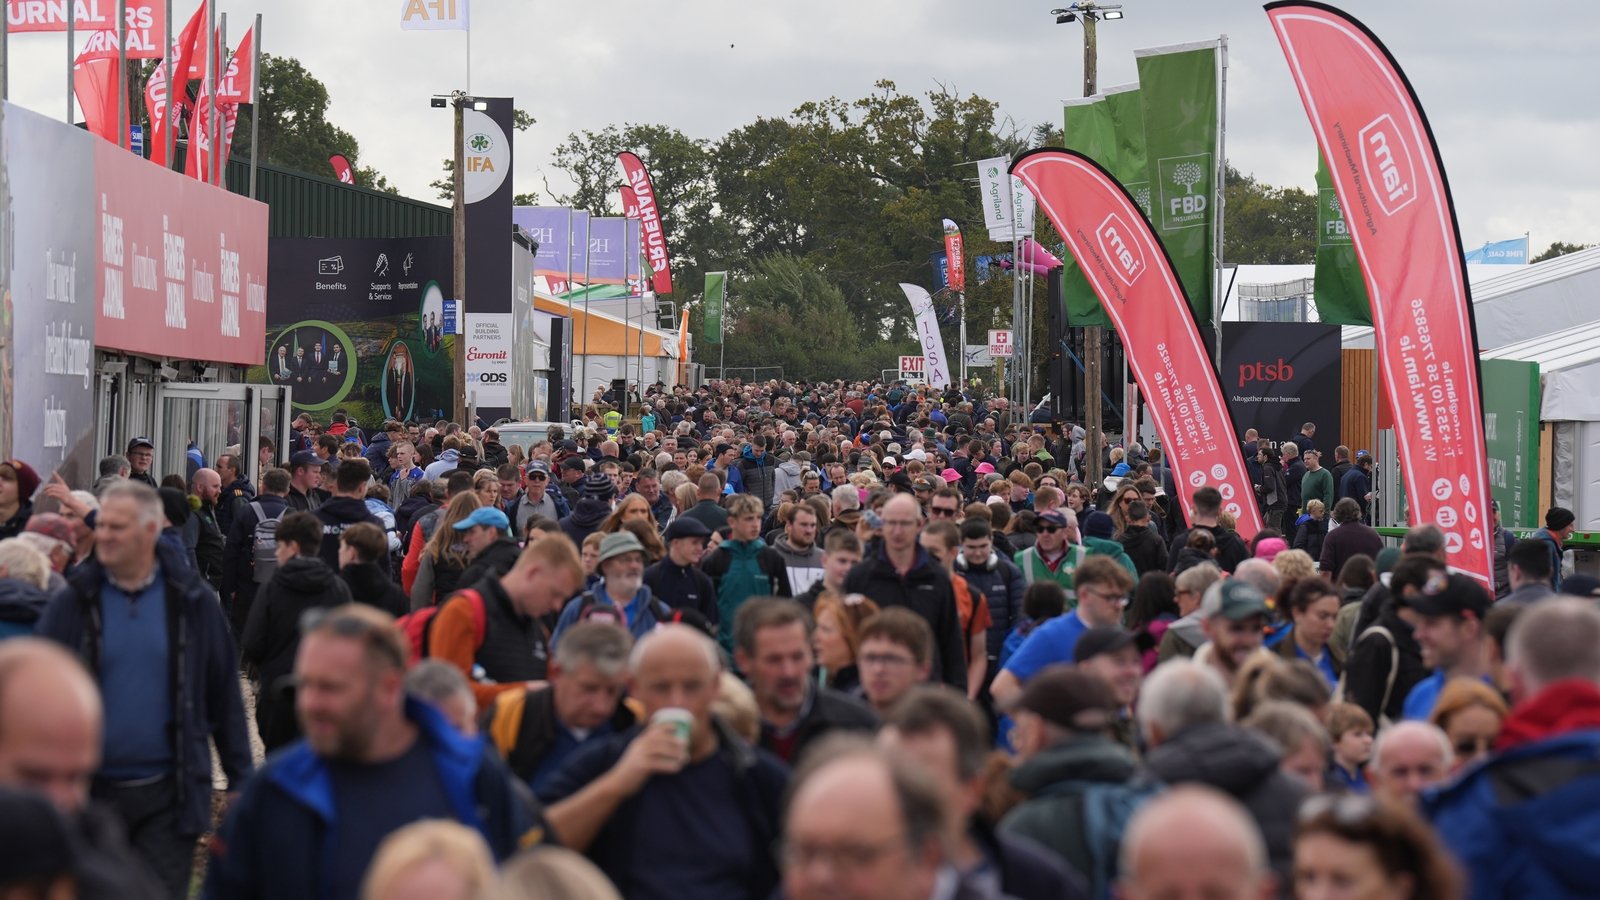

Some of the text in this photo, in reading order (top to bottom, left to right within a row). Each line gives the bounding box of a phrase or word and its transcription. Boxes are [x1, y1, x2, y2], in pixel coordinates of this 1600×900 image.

[467, 157, 495, 172] IFA
[990, 181, 1005, 221] Agriland
[1170, 194, 1206, 215] FBD
[1014, 191, 1025, 229] Agriland
[1173, 213, 1204, 223] INSURANCE
[102, 212, 124, 267] FARMERS
[163, 232, 186, 282] FARMERS
[220, 249, 240, 294] FARMERS
[315, 282, 347, 290] Benefits
[370, 283, 392, 291] Supports
[368, 292, 392, 300] & Services
[466, 346, 507, 361] Euronit
[991, 345, 1013, 354] FIRST AID
[901, 357, 925, 371] EXIT
[480, 372, 507, 383] ODS
[1238, 358, 1295, 388] ptsb
[1231, 395, 1262, 403] Altogether
